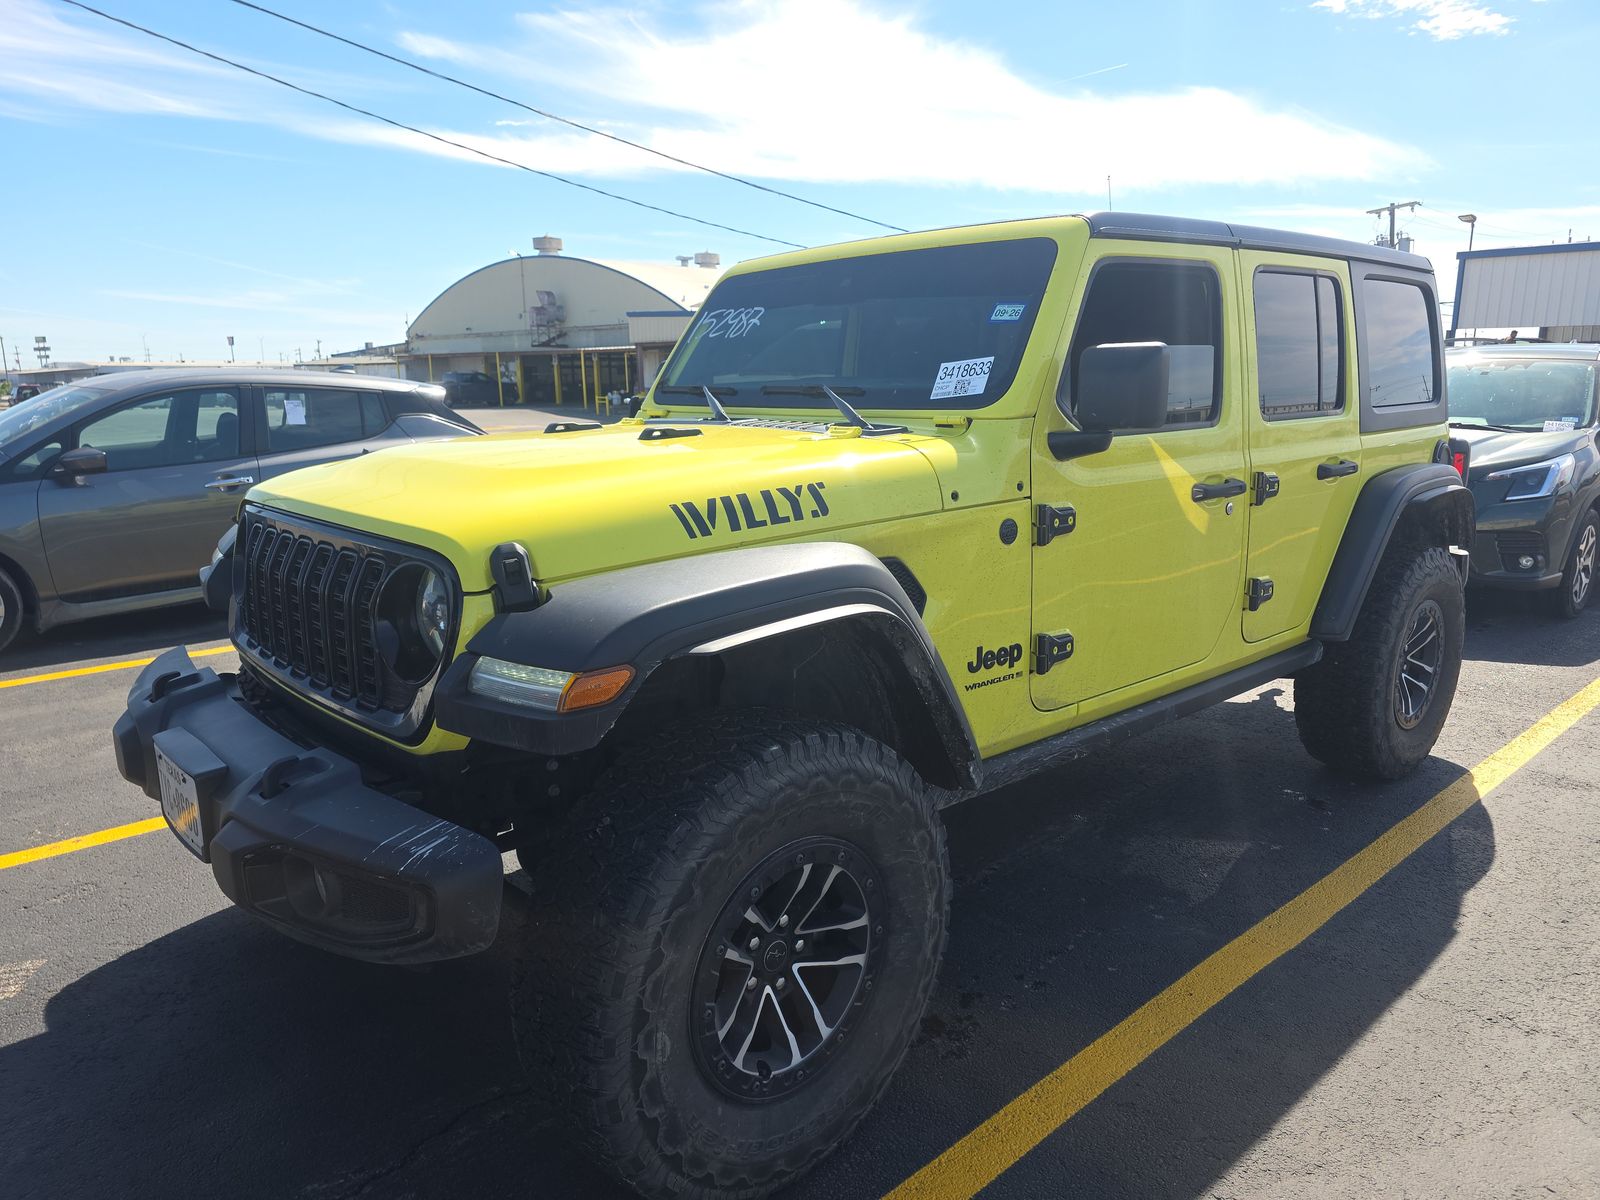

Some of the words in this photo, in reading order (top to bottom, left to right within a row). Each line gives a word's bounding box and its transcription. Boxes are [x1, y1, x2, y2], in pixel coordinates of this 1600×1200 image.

[940, 361, 992, 381] 3418633
[669, 482, 829, 539] WILLYS
[967, 643, 1023, 673] Jeep
[964, 673, 1014, 692] WRANGLER
